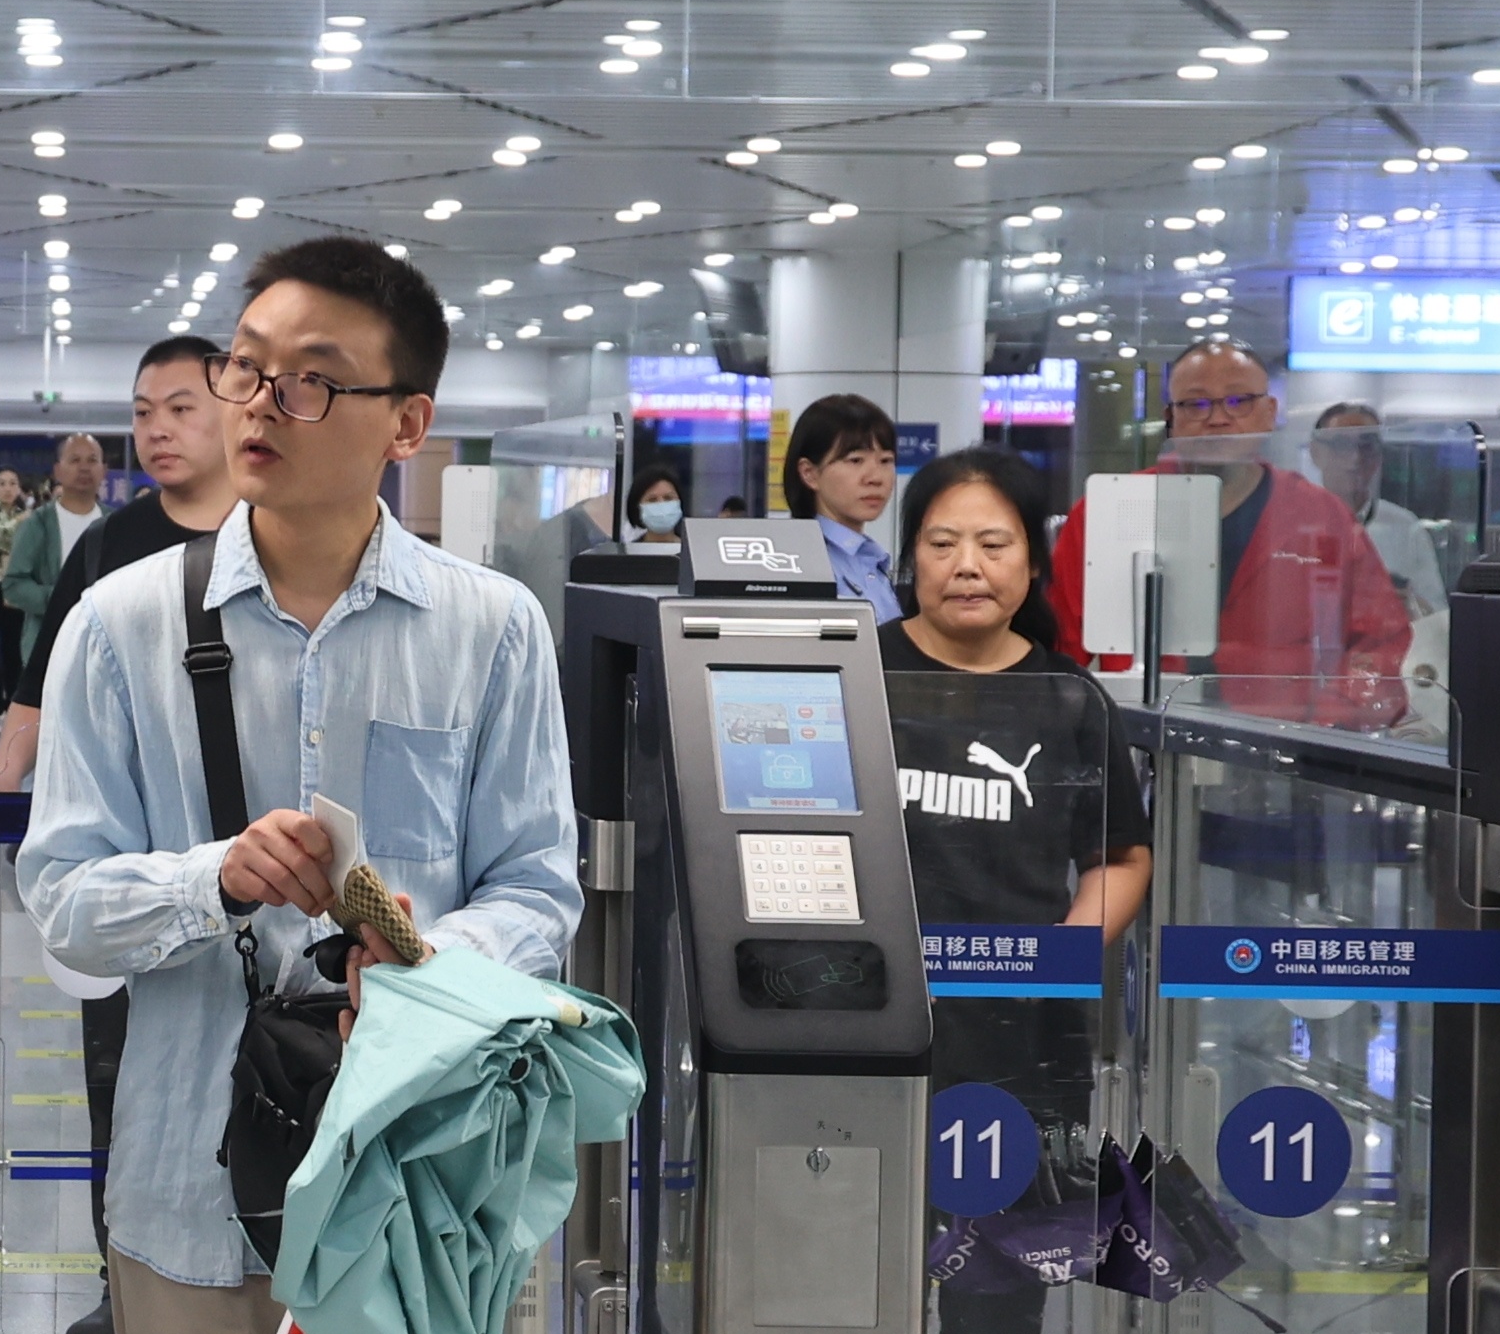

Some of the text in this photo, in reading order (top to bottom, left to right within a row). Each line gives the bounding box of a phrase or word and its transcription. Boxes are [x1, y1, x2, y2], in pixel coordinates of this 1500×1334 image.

[898, 768, 1012, 822] PUMA
[923, 936, 1038, 957] 国移民管理
[1270, 938, 1416, 961] 中国移民管理
[948, 961, 1034, 971] IMMIGRATION
[1275, 964, 1411, 975] CHINA IMMIGRATION
[939, 1119, 1001, 1179] 11
[1249, 1121, 1314, 1182] 11
